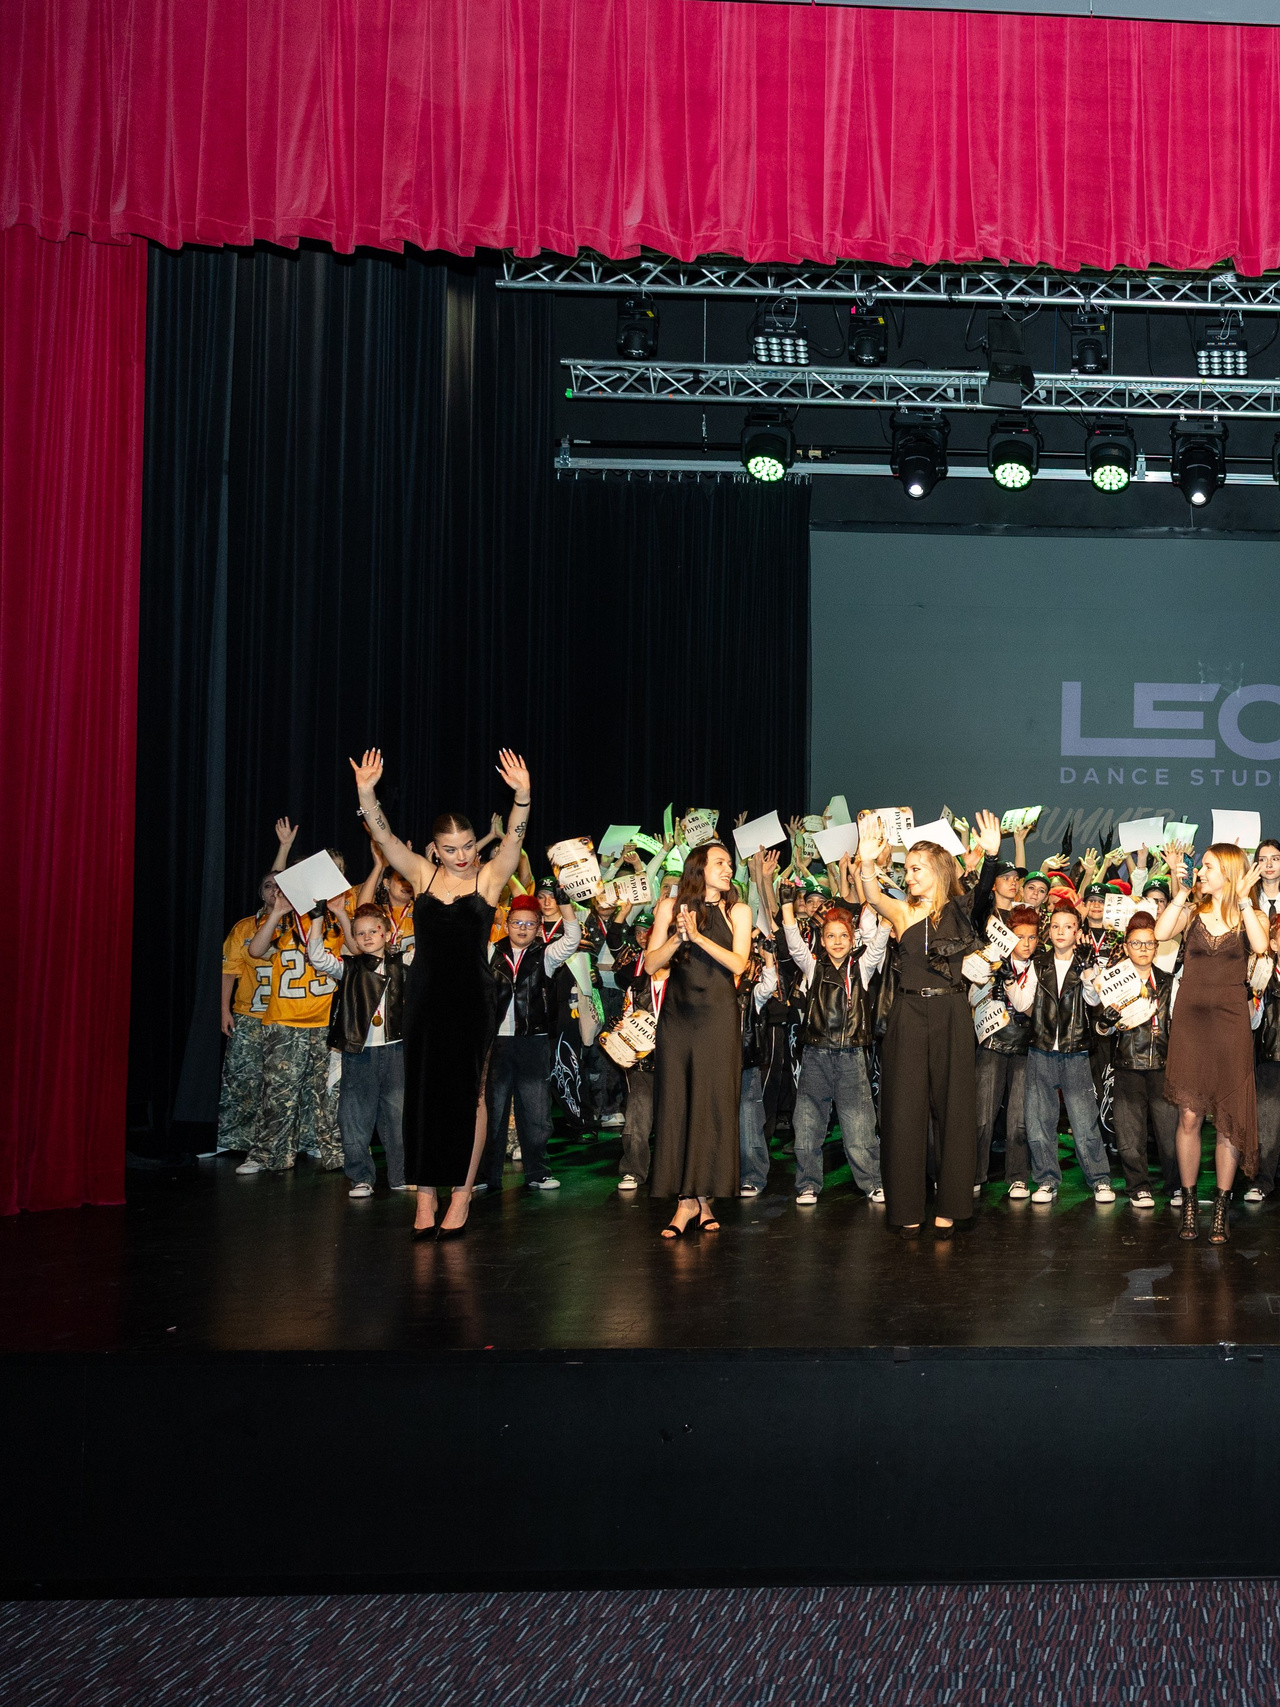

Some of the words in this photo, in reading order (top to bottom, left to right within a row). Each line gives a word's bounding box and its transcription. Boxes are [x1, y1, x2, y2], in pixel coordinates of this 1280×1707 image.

[1060, 767, 1170, 786] DANCE
[894, 811, 903, 844] DYPLM
[1025, 806, 1176, 845] SUMM
[564, 875, 597, 891] DYPLOM
[640, 877, 648, 891] LEO
[576, 889, 592, 898] LEO
[992, 921, 1007, 936] LEO
[986, 930, 1010, 953] PLOM
[1103, 968, 1121, 982] LEO
[1101, 972, 1137, 996] DYPLOM
[975, 1007, 1003, 1030] DYPLOM
[985, 1021, 1000, 1034] LEO
